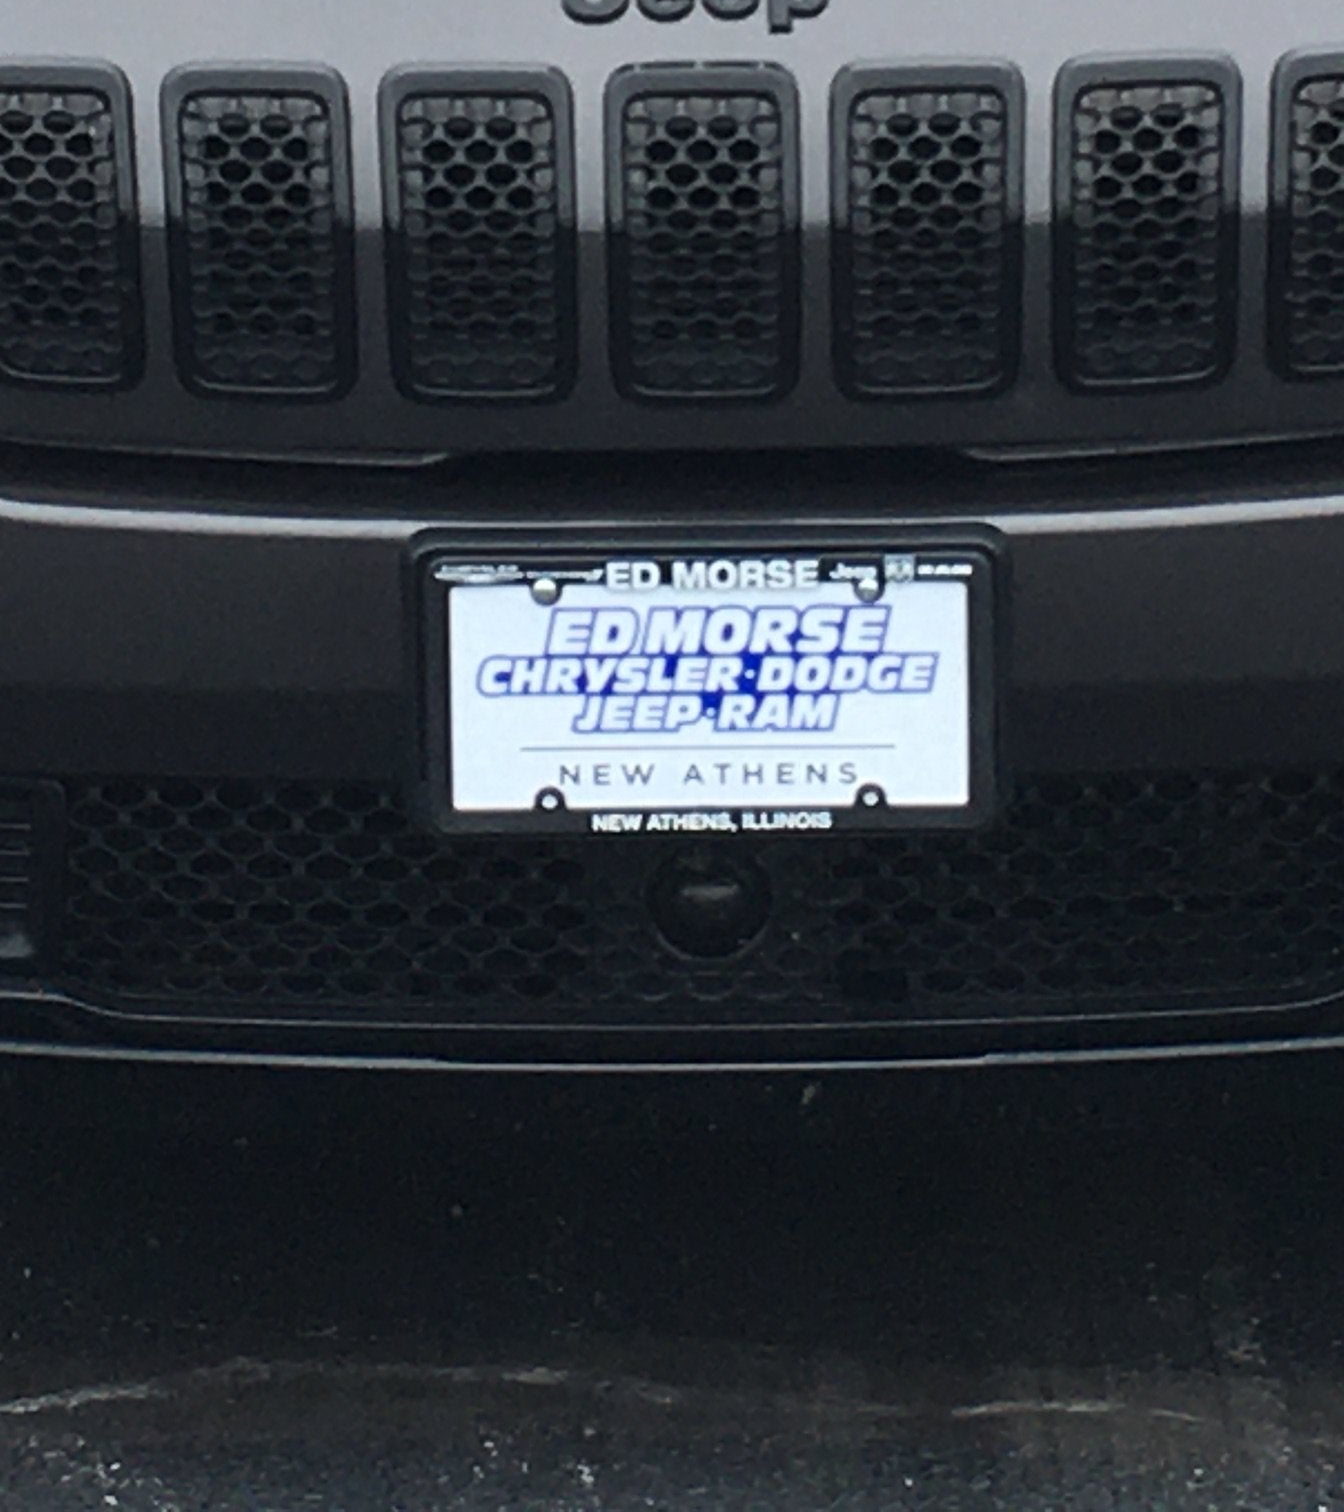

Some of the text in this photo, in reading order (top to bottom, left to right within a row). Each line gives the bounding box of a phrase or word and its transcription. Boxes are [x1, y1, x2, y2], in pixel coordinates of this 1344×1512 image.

[607, 561, 661, 589] ED
[672, 560, 819, 589] MORSE
[545, 604, 892, 657] ED MORSE
[559, 762, 858, 786] NEW ATHENS
[591, 811, 833, 833] NEW ATHENS, ILLINOIS
